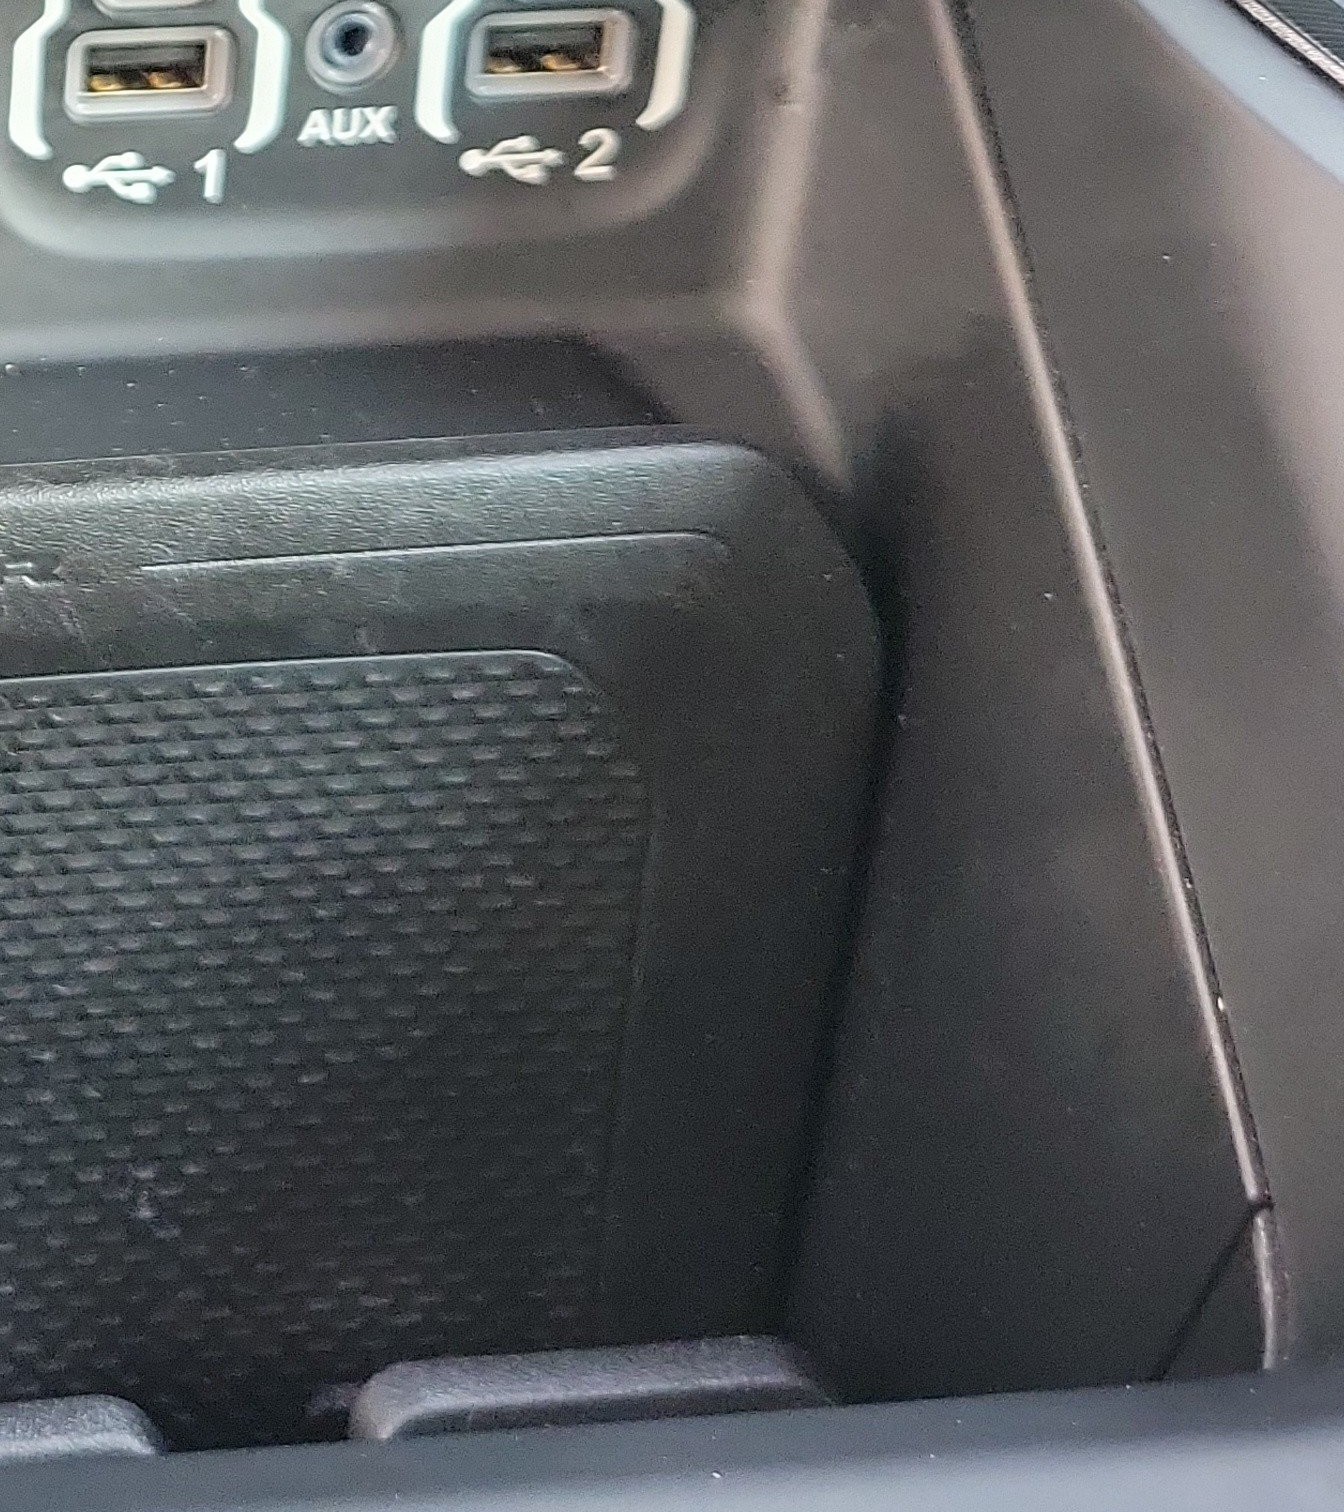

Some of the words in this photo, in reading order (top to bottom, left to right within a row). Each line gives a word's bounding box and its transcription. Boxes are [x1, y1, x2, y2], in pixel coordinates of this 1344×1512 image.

[297, 104, 398, 146] AUX
[193, 148, 227, 204] 1
[574, 128, 621, 180] 2
